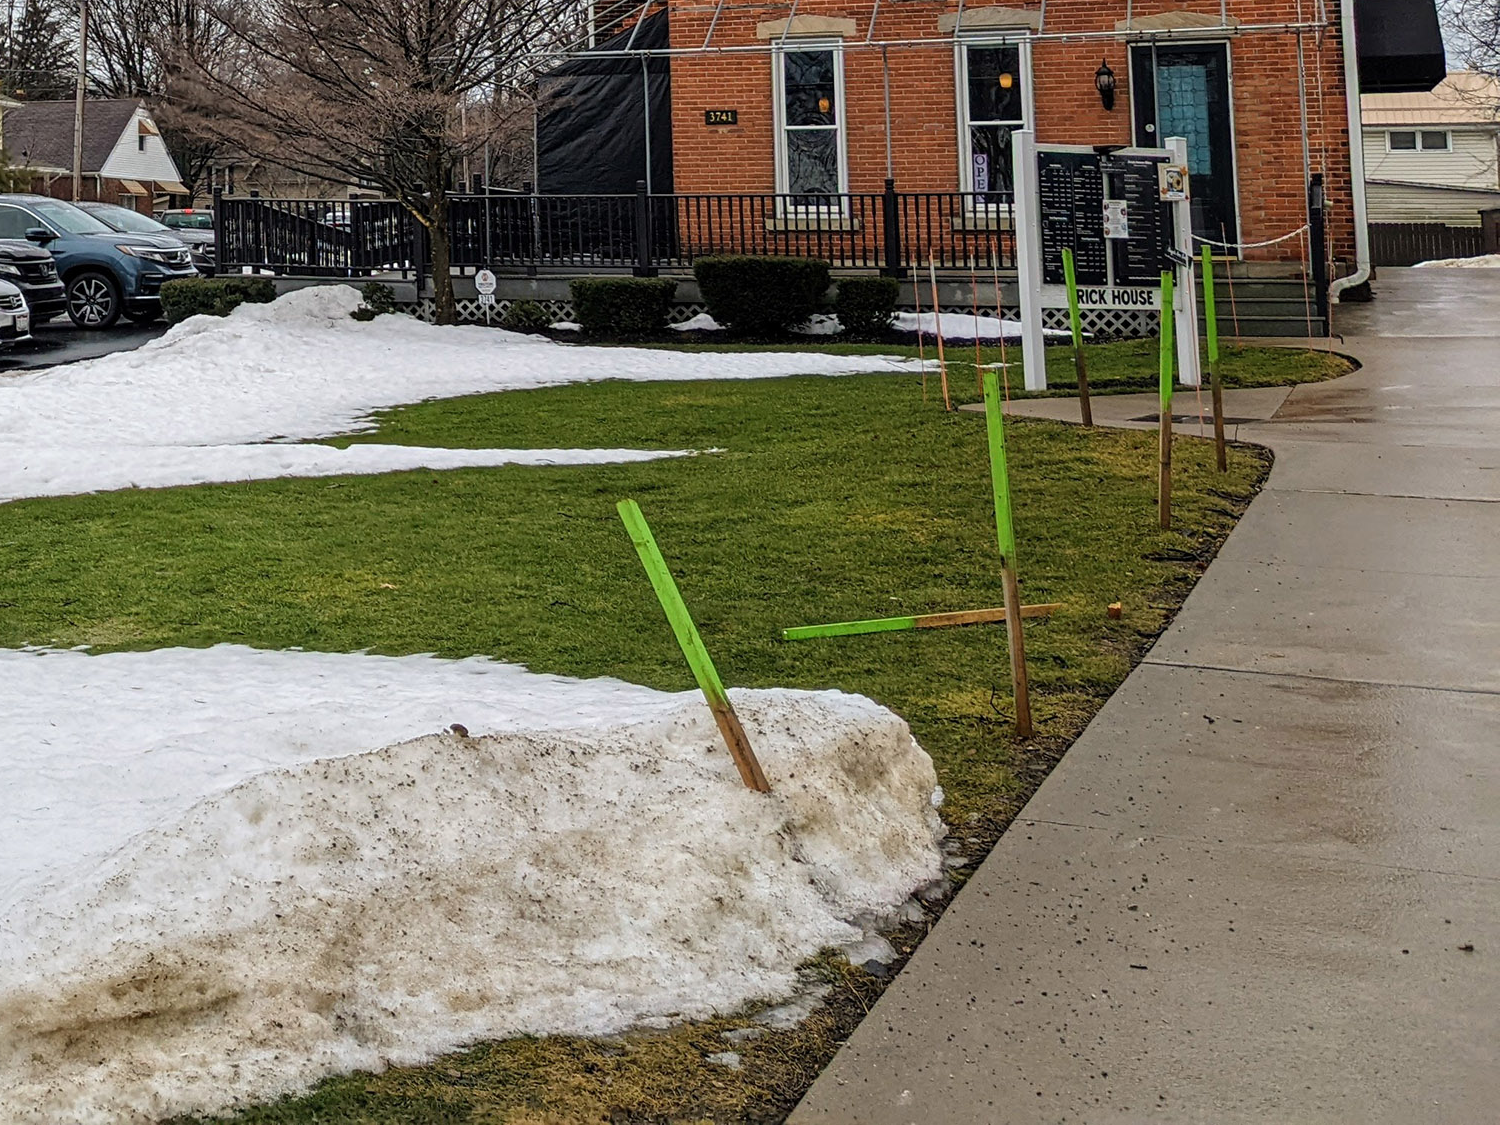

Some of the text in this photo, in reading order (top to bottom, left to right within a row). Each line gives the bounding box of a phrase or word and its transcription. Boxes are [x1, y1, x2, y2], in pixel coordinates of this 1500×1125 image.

[709, 111, 733, 122] 3741
[1076, 288, 1154, 306] RICK HOUSE
